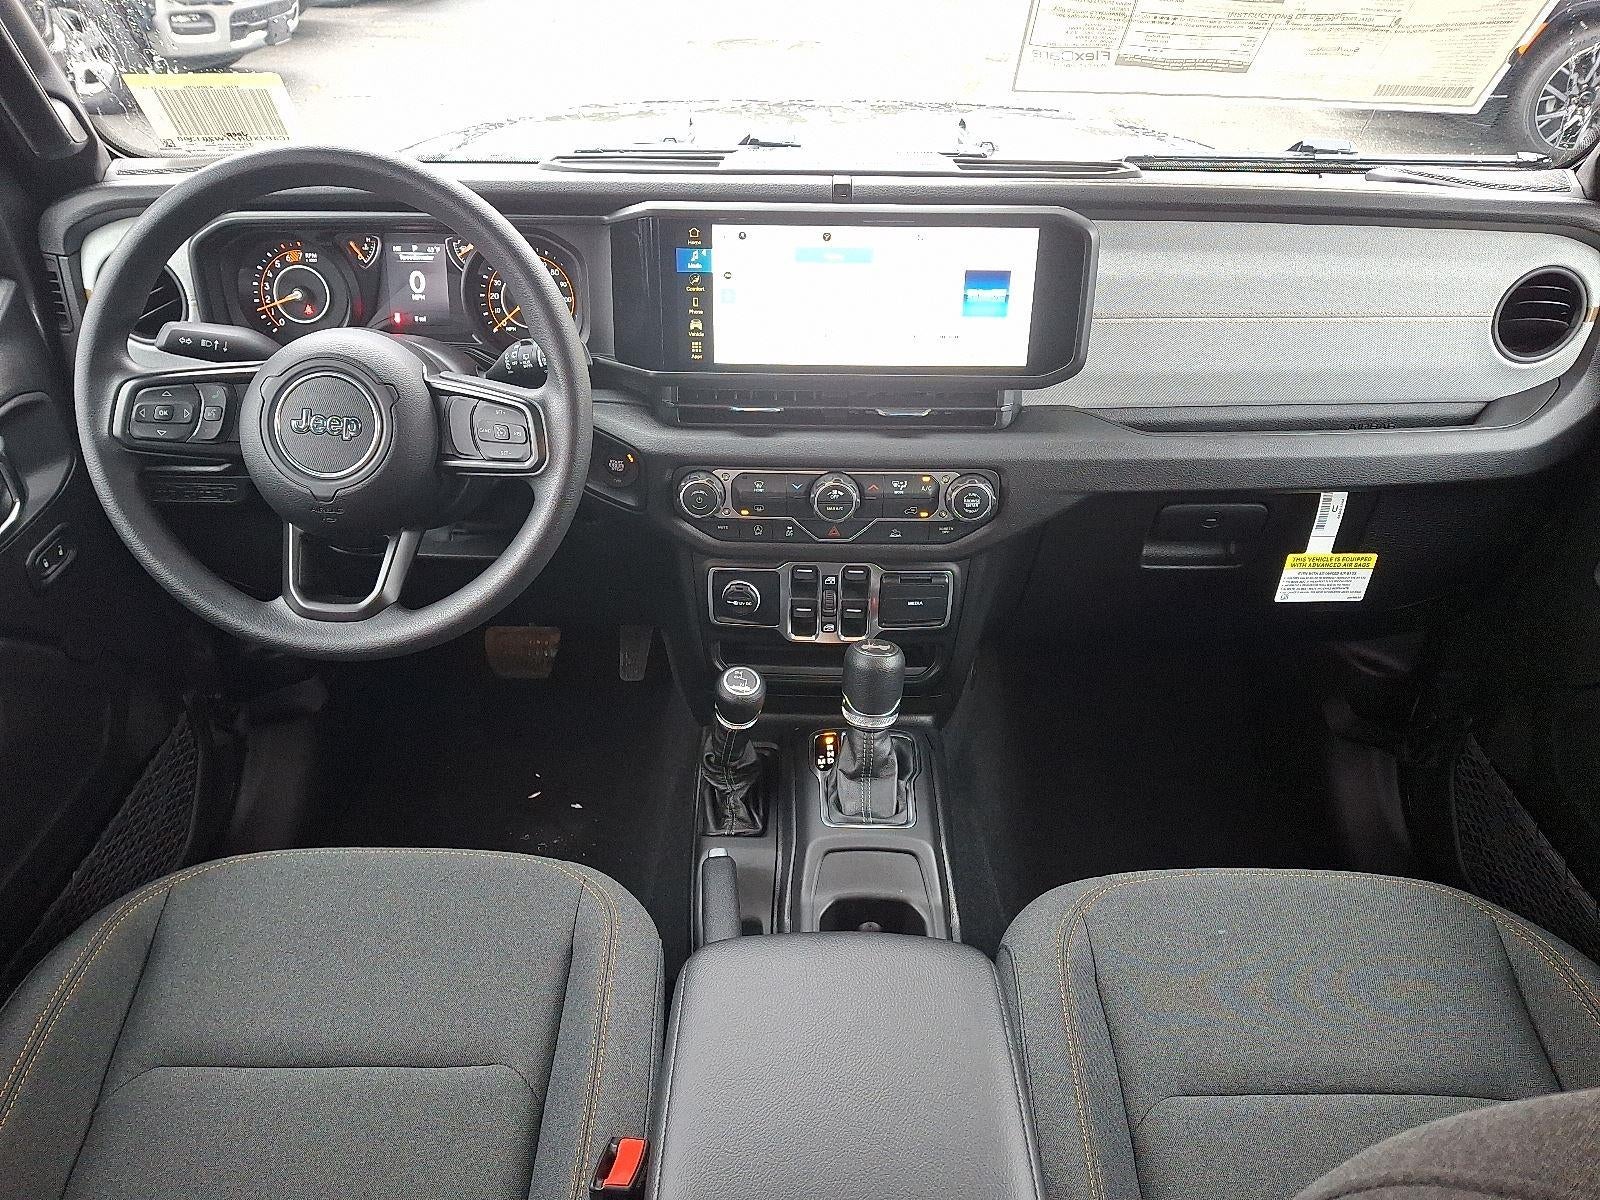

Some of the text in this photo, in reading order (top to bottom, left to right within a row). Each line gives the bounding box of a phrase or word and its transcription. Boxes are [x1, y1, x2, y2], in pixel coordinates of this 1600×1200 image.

[409, 270, 426, 294] 0
[490, 292, 500, 300] 20
[290, 408, 362, 441] Jeep
